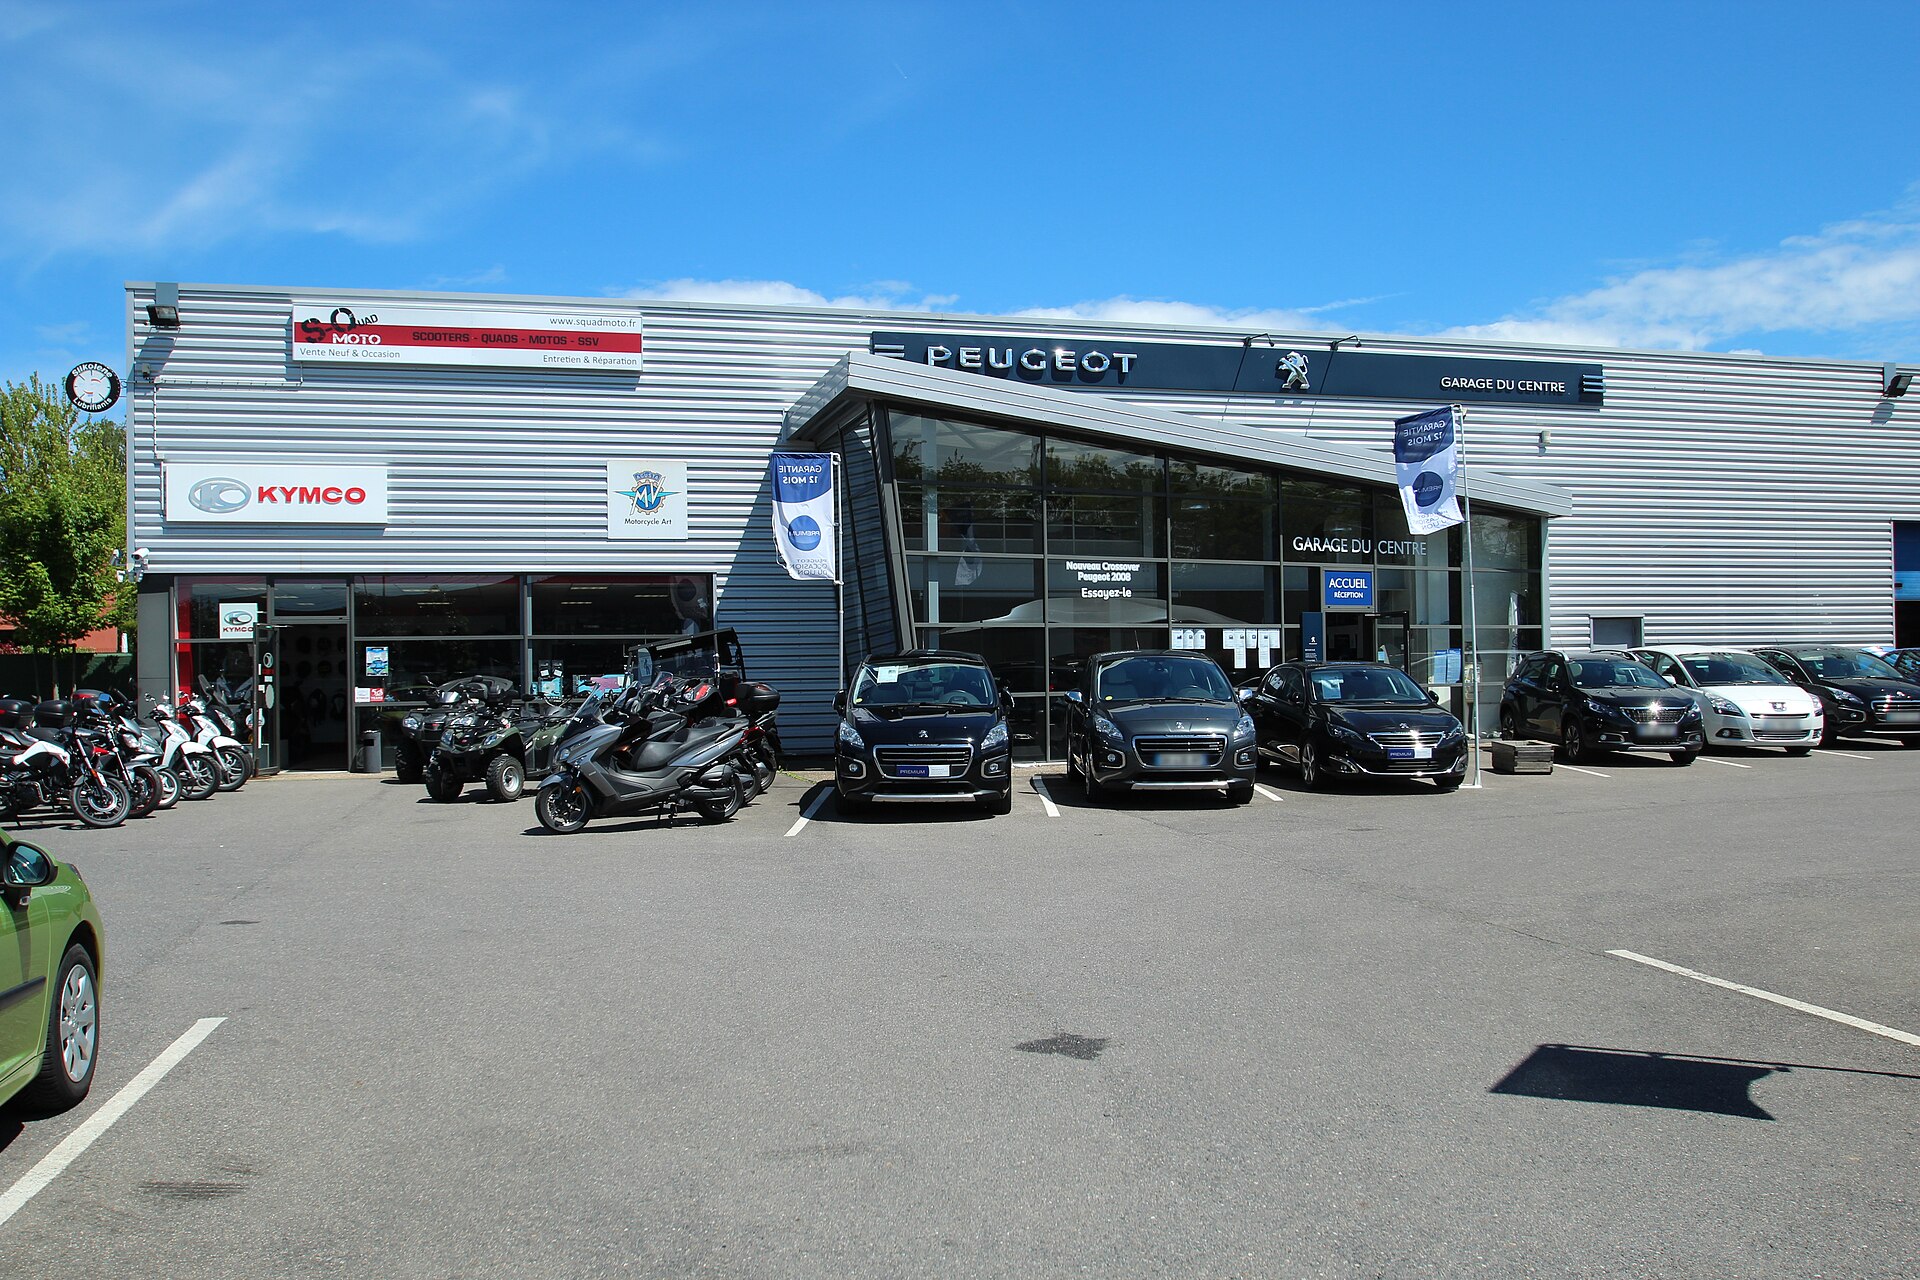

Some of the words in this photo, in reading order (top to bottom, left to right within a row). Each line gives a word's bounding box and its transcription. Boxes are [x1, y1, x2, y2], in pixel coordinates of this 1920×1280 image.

[549, 317, 637, 328] www.squadmoto.fr
[332, 333, 382, 345] MOTO
[412, 331, 470, 343] SCOOTERS
[481, 333, 518, 344] QUADS
[528, 335, 567, 345] MOTOS
[578, 337, 599, 346] SSV
[300, 347, 326, 357] Vente
[328, 348, 349, 358] Neuf
[351, 350, 359, 358] &
[361, 349, 401, 359] Occasion
[543, 354, 582, 364] Entretien
[583, 355, 591, 364] &
[592, 356, 637, 366] Réparation
[927, 346, 1137, 373] PEUGEOT
[72, 363, 112, 377] Silkolene
[1441, 376, 1494, 390] GARAGE
[1496, 379, 1515, 391] DU
[1517, 380, 1566, 393] CENTRE
[73, 398, 112, 410] Lubrifiants
[258, 486, 366, 505] KYMCO
[624, 518, 660, 526] Motorcycle
[1292, 536, 1349, 553] GARAGE
[1351, 539, 1371, 554] DU
[1377, 540, 1427, 556] CENTRE
[1065, 561, 1101, 571] Nouveau
[1101, 562, 1140, 572] Crossover
[1077, 571, 1111, 583] Peugeot
[1111, 572, 1132, 582] 2008
[1328, 578, 1368, 589] ACCUEIL
[1081, 586, 1132, 600] Essayez-le
[1333, 591, 1364, 599] RÉCEPTION
